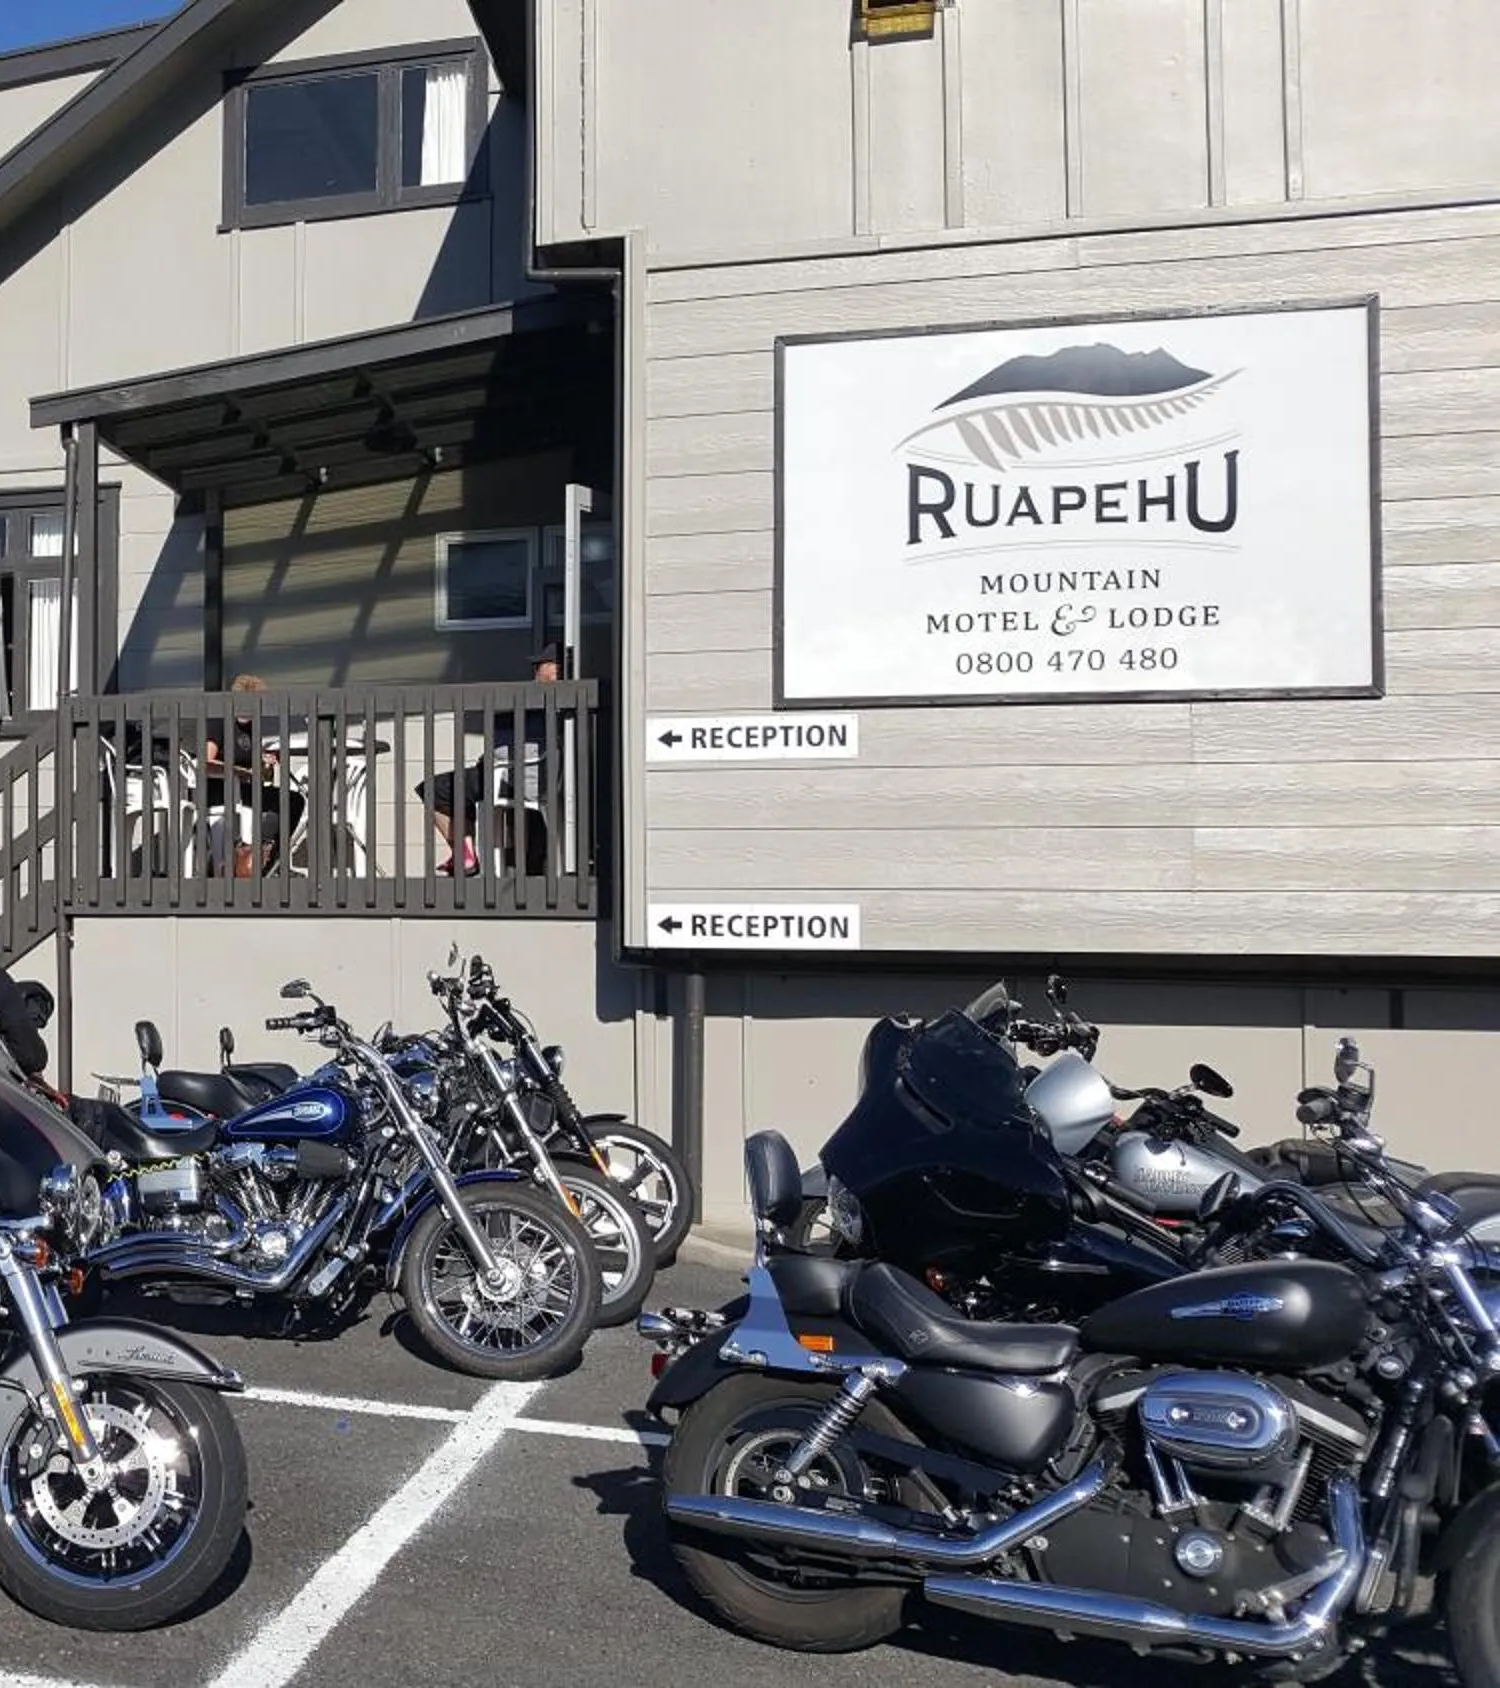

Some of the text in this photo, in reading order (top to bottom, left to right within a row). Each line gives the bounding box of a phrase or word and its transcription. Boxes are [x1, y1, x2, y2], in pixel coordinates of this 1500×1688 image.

[906, 449, 1239, 545] RUAPEHU
[980, 568, 1161, 595] MOUNTAIN
[926, 604, 1221, 636] MOTEL & LODGE
[955, 647, 1179, 675] 0800 470 480
[691, 724, 847, 749] RECEPTION
[691, 914, 850, 939] RECEPTION
